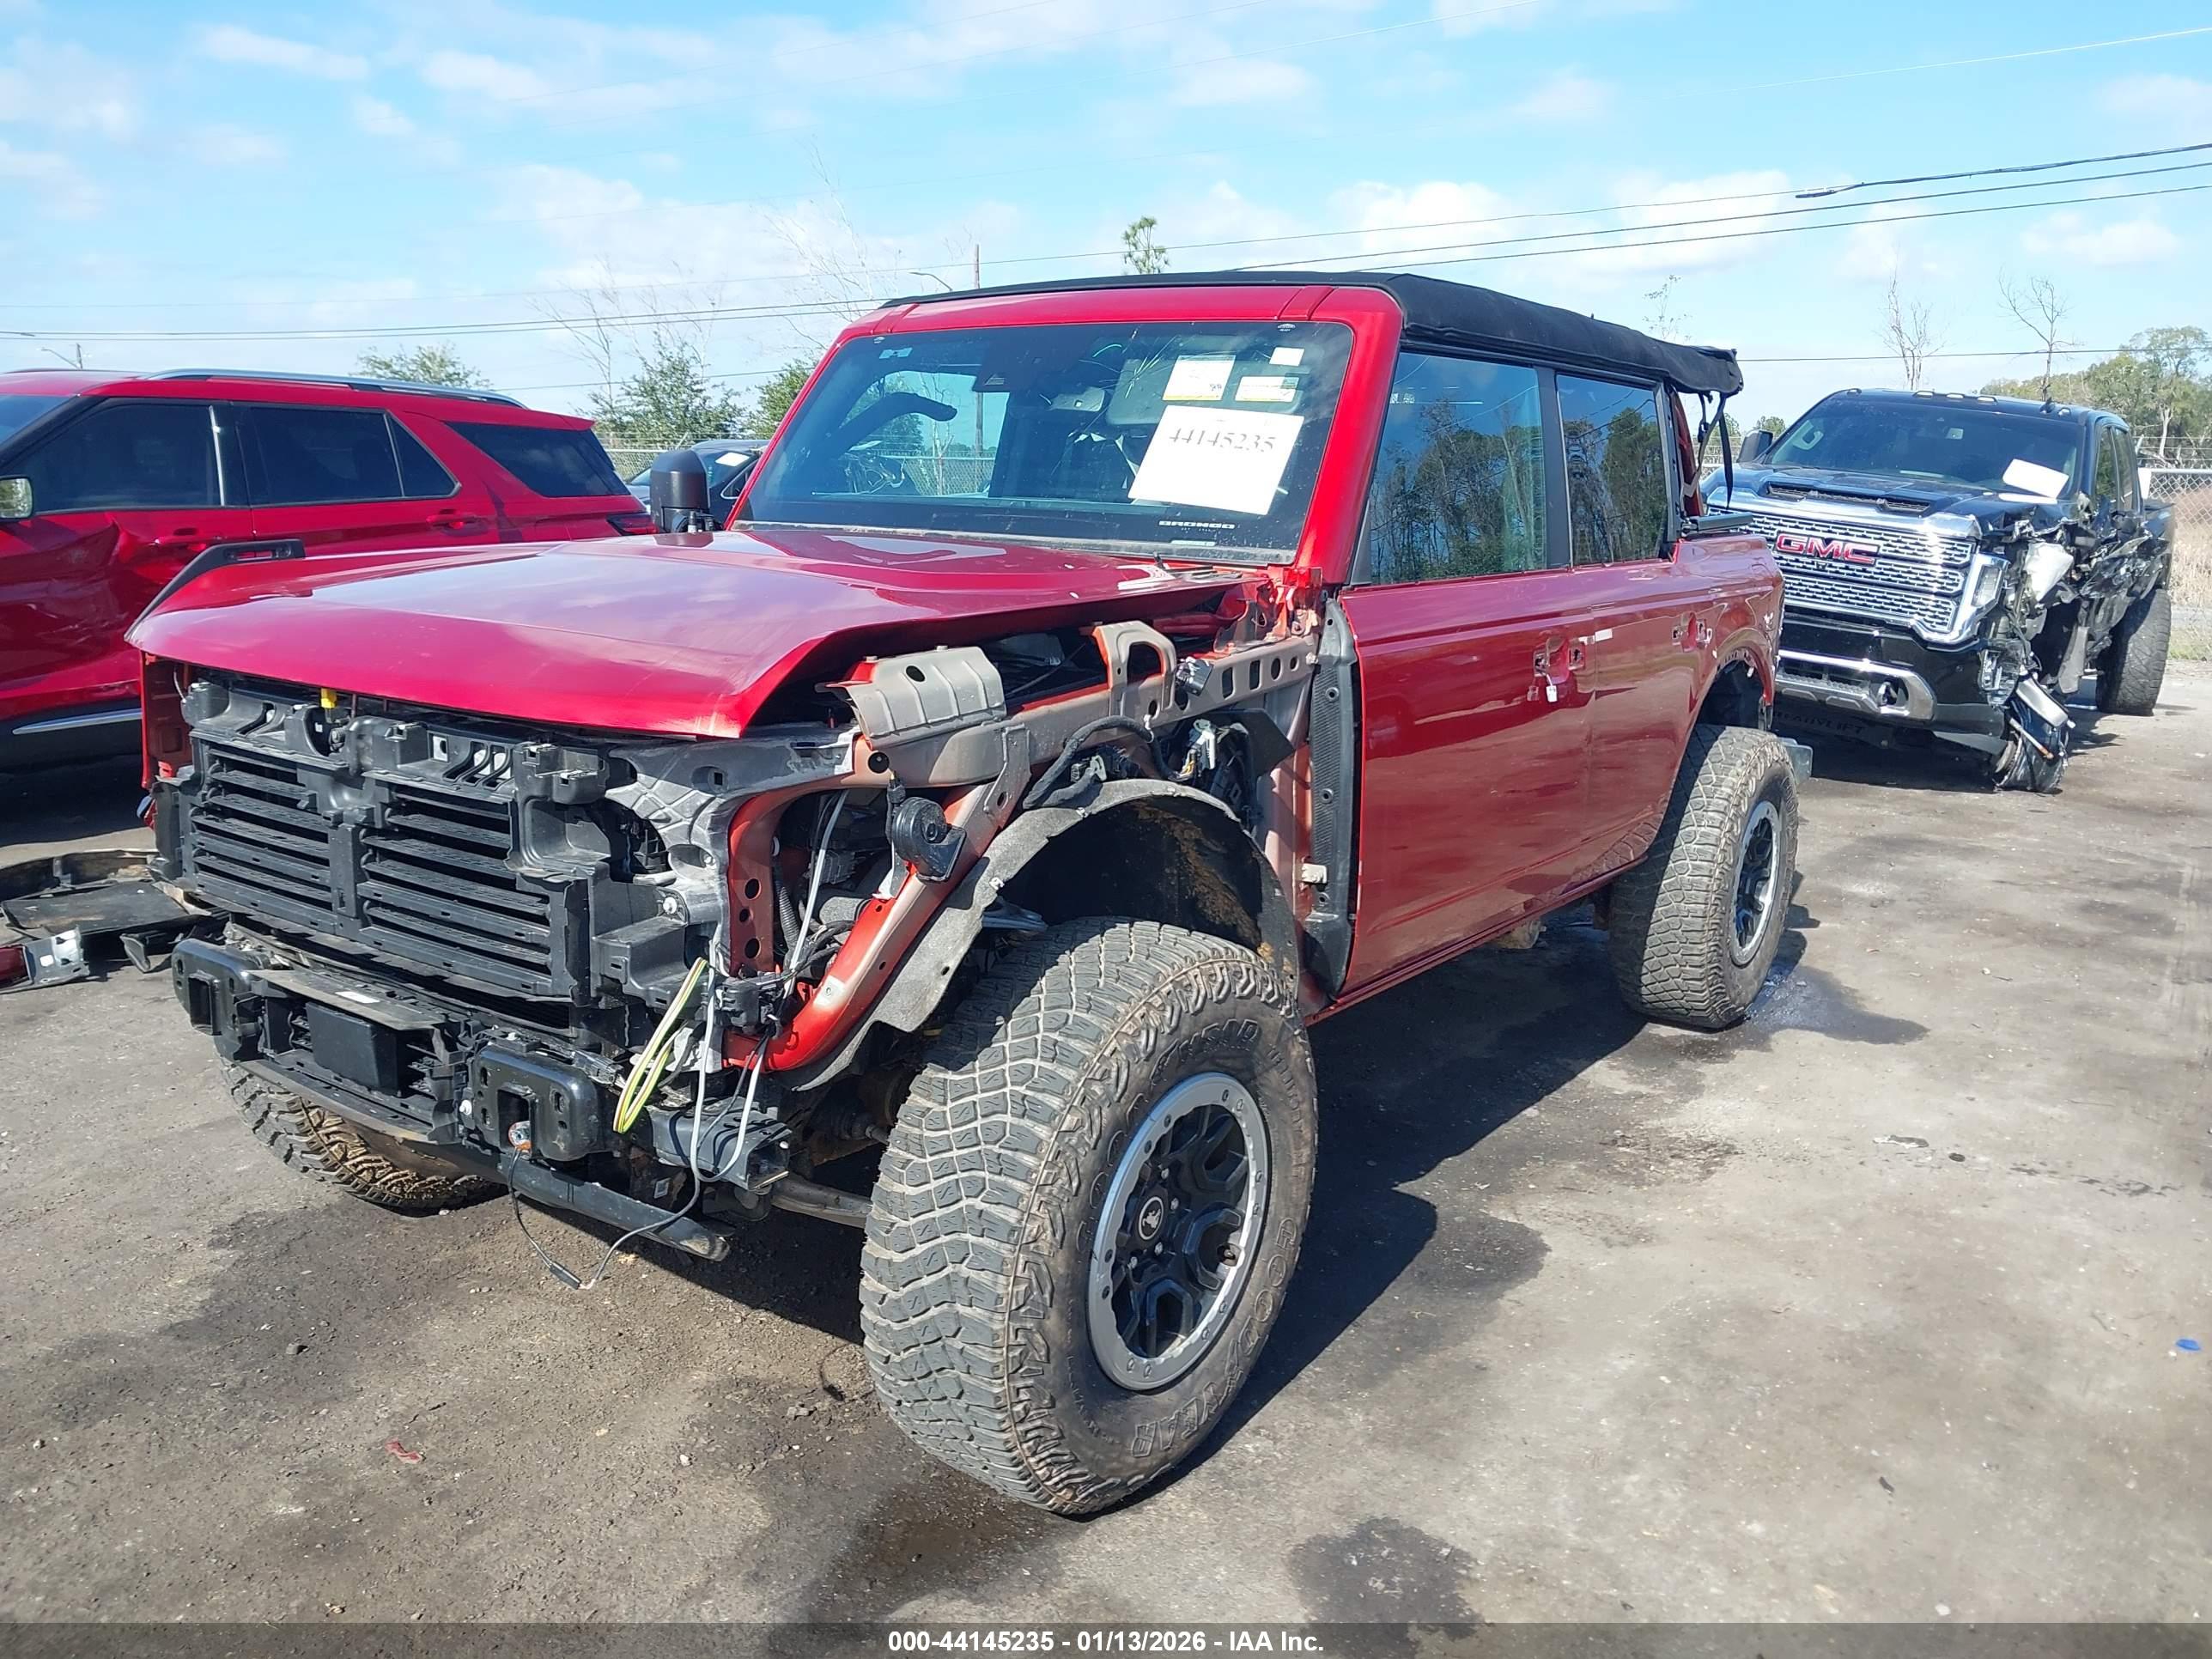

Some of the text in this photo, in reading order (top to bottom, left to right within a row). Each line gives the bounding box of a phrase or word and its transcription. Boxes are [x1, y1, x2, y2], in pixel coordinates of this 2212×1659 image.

[1170, 428, 1275, 453] 44145235
[1775, 532, 1881, 566] GMC
[1130, 1216, 1298, 1459] GOODYEAR
